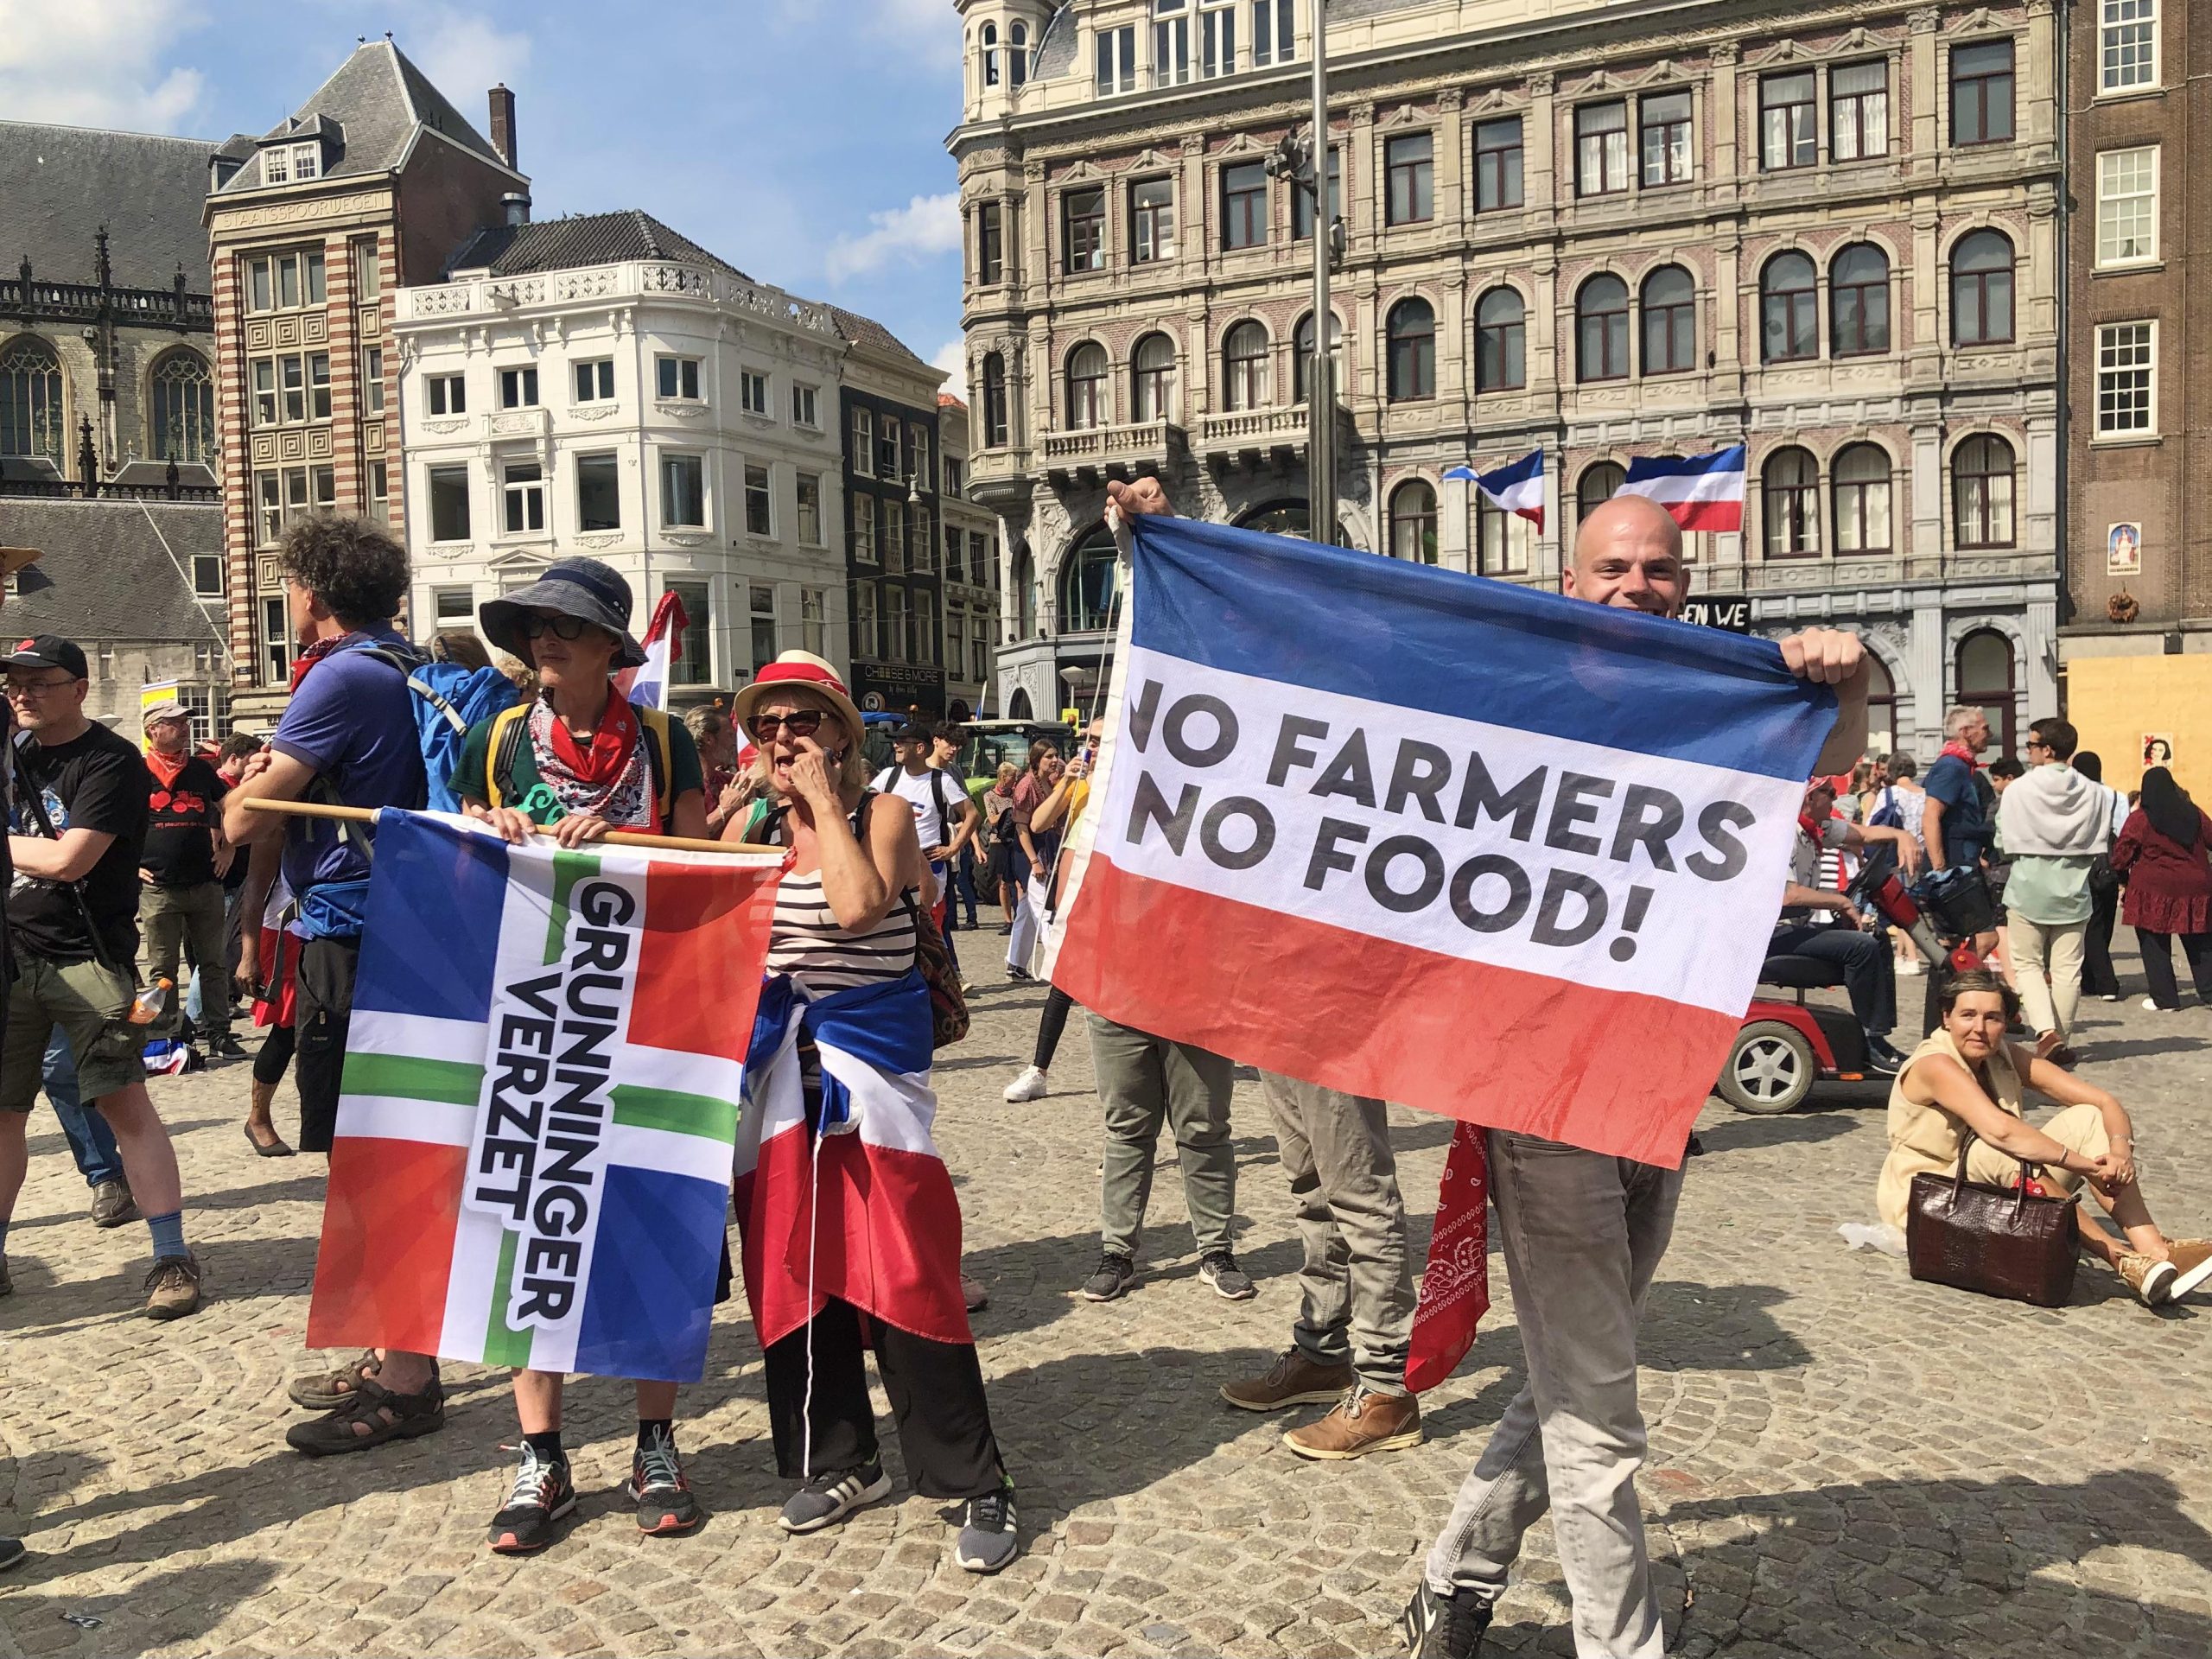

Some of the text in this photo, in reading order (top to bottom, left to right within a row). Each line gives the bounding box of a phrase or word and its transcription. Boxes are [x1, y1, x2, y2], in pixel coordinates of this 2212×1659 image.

[223, 193, 385, 228] STAATSSPOORWEGEN
[865, 665, 938, 683] CHEESE & MORE
[1715, 604, 1748, 626] WE
[1126, 770, 1655, 963] NO FOOD!
[1266, 713, 1756, 882] FARMERS
[476, 972, 563, 1221] VERZET
[517, 881, 637, 1321] GRUNNINGER
